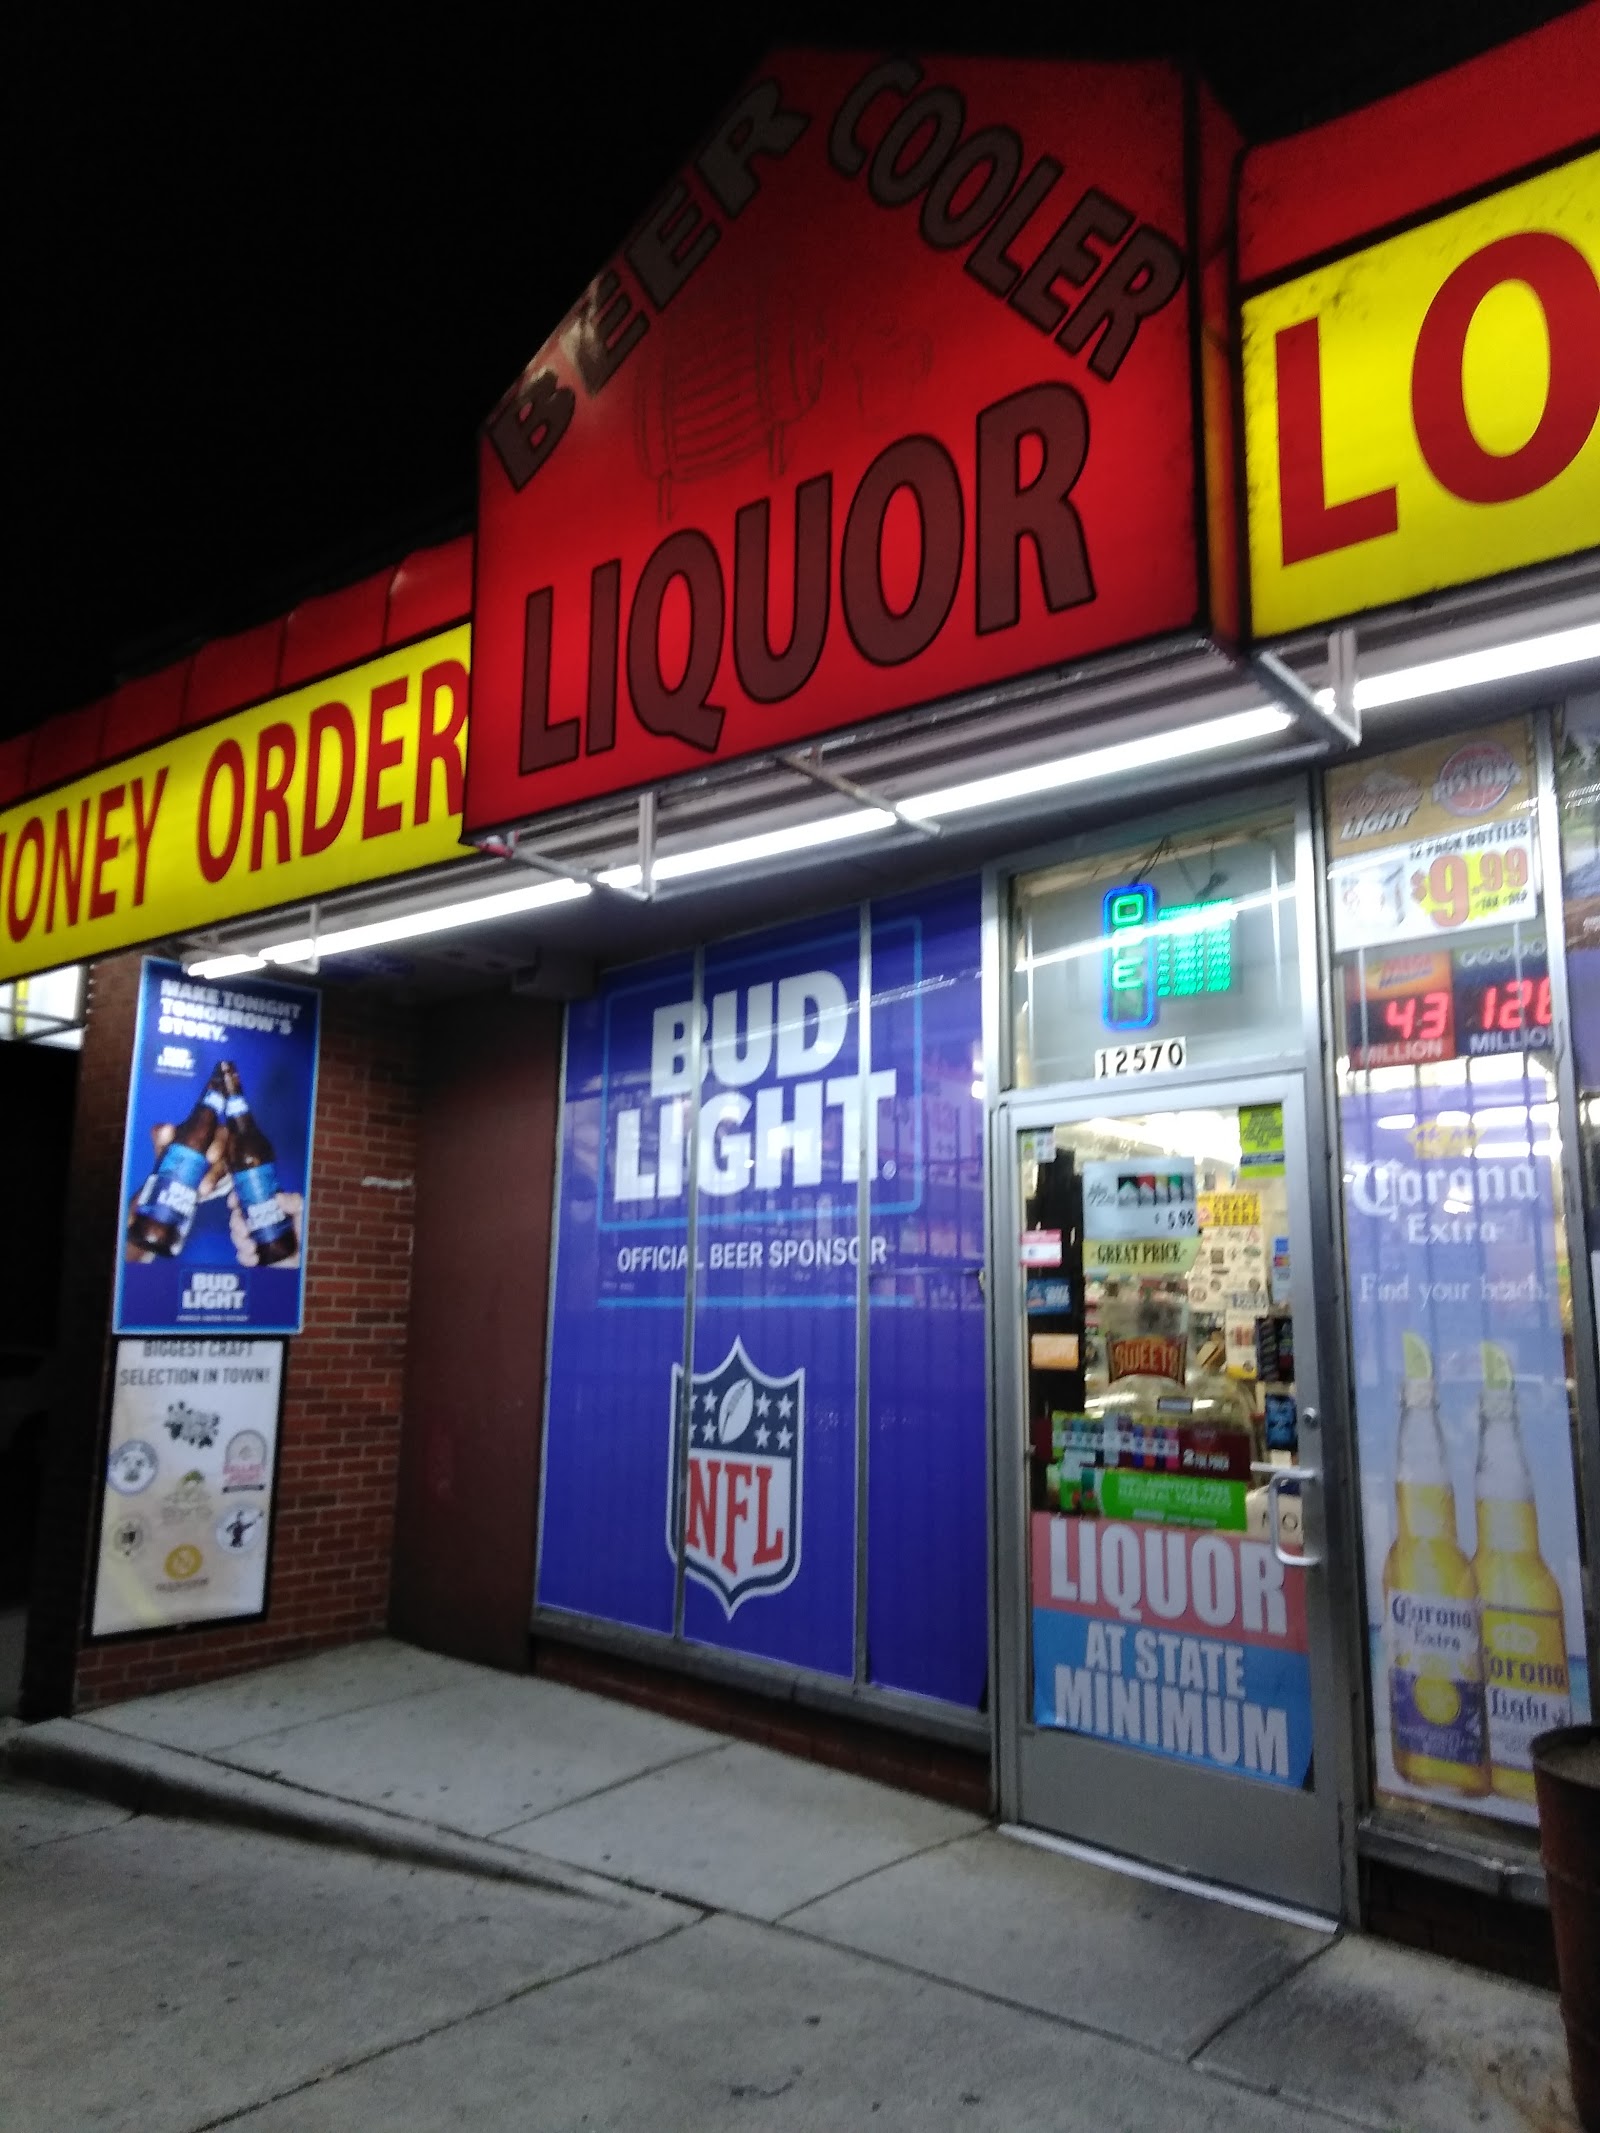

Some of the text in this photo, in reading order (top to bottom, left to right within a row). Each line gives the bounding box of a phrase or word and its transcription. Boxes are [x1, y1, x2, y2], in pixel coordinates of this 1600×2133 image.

[486, 57, 1184, 492] BEER COOLER
[1275, 229, 1600, 568] LO
[517, 381, 1097, 777] LIQUOR
[196, 659, 469, 883] ORDER
[651, 970, 848, 1098] BUD
[1386, 991, 1449, 1039] 43
[1100, 1043, 1183, 1077] 12570
[614, 1068, 897, 1202] LIGHT
[1348, 1158, 1542, 1222] Corona
[1406, 1212, 1500, 1246] Extra
[191, 1272, 240, 1292] BUD
[709, 1241, 763, 1270] BEER
[1142, 1240, 1181, 1264] PRICE
[181, 1289, 247, 1310] LIGHT
[120, 1368, 200, 1387] SELECTION
[202, 1368, 218, 1384] IN
[686, 1457, 784, 1577] NFL
[1050, 1518, 1288, 1636] LIQUOR
[1086, 1621, 1246, 1701] AT STATE
[1055, 1664, 1290, 1780] MINIMUM
